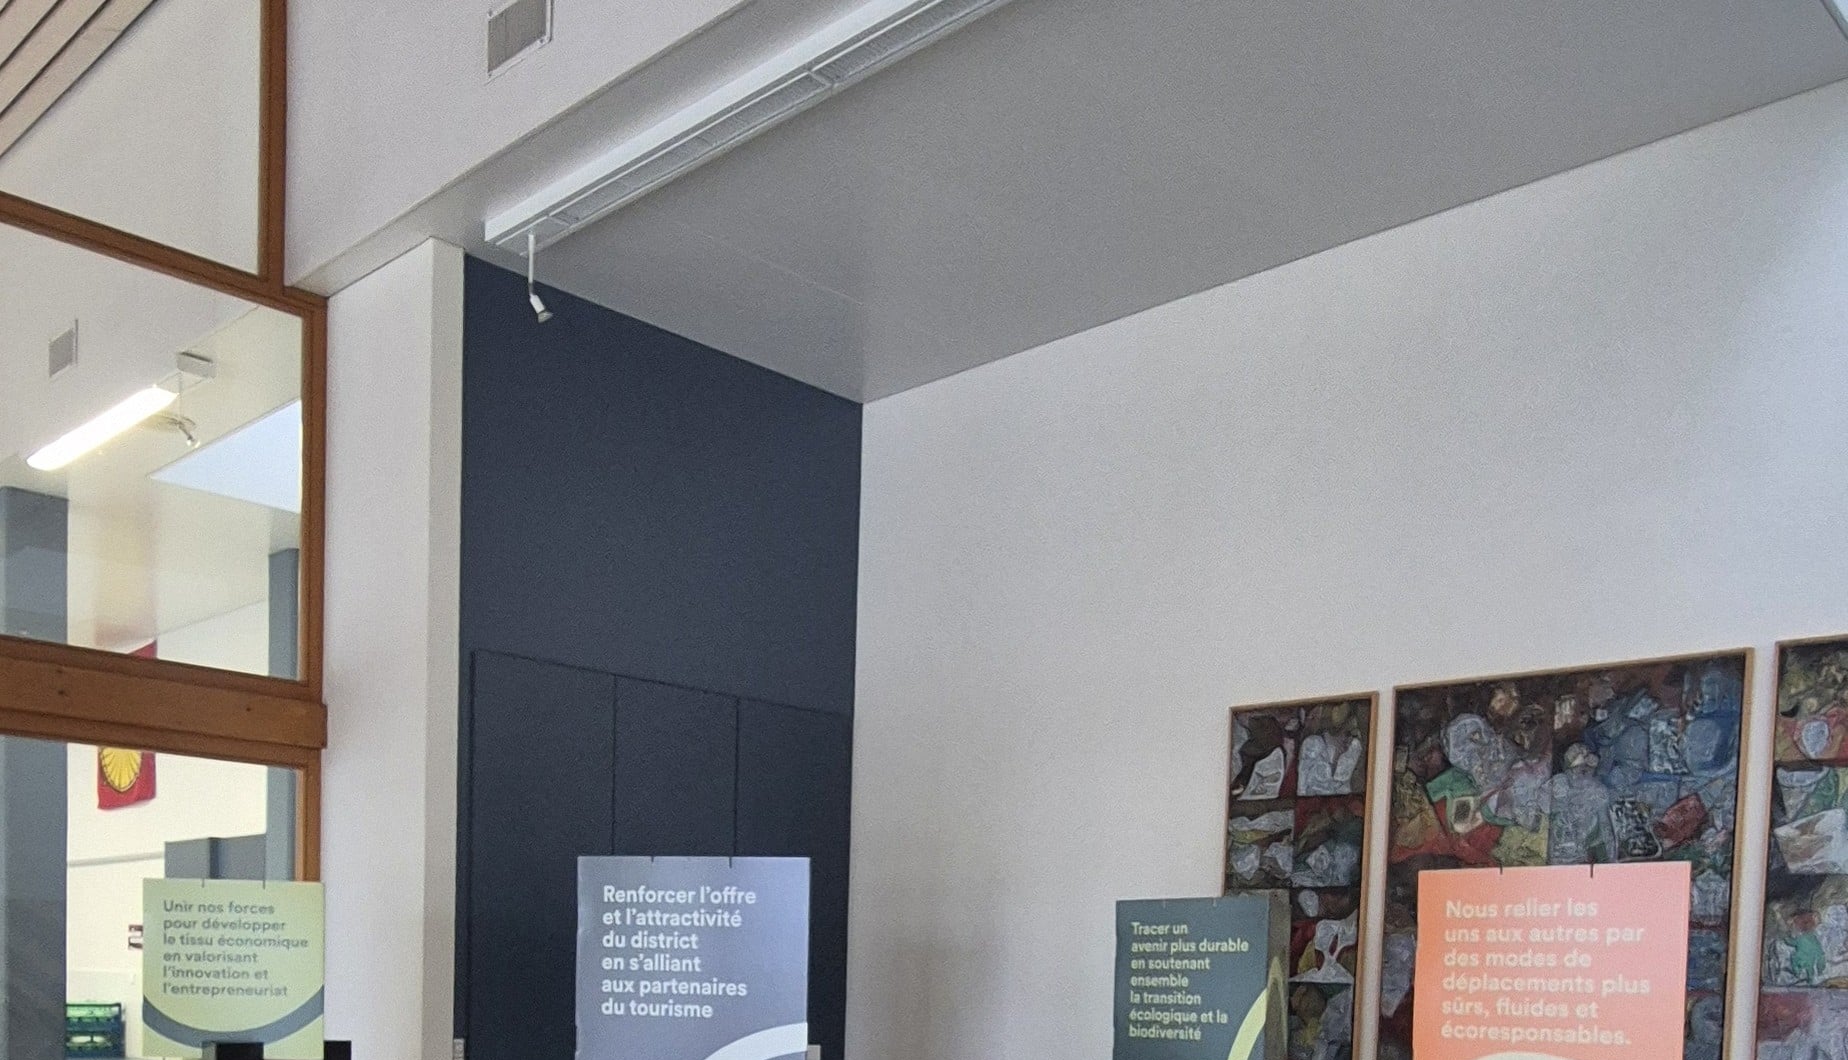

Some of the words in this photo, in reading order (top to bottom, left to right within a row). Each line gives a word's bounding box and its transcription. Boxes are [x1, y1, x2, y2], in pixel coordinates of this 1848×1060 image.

[603, 885, 696, 903] Renforcer
[700, 886, 756, 904] l'offre
[163, 901, 193, 912] Unir
[198, 903, 224, 912] nos
[229, 901, 275, 914] forces
[1446, 901, 1498, 919] Nous
[1504, 899, 1560, 918] relier
[1567, 898, 1597, 916] les
[163, 920, 197, 930] pour
[202, 918, 285, 932] développer
[603, 909, 621, 926] et
[626, 908, 742, 927] l'attractivité
[1131, 922, 1170, 935] Tracer
[1173, 925, 1188, 934] un
[1445, 928, 1480, 943] uns
[1486, 928, 1523, 943] aux
[1529, 927, 1599, 943] autres
[1606, 927, 1645, 945] par
[163, 934, 176, 945] le
[180, 934, 213, 946] tissu
[217, 936, 308, 950] économique
[602, 931, 625, 948] du
[631, 931, 699, 949] district
[1131, 939, 1167, 952] avenir
[1170, 939, 1196, 955] plus
[1199, 938, 1249, 951] durable
[163, 953, 181, 962] en
[186, 951, 258, 963] valorisant
[602, 956, 624, 970] en
[629, 954, 701, 972] s'alliant
[1131, 959, 1145, 969] en
[1148, 957, 1210, 969] soutenant
[1444, 949, 1479, 967] des
[1486, 949, 1557, 967] modes
[1564, 950, 1591, 967] de
[163, 967, 250, 979] l'innovation
[254, 969, 269, 980] et
[1130, 974, 1189, 987] ensemble
[163, 983, 288, 997] l'entrepreneuriat
[601, 980, 635, 992] aux
[639, 978, 748, 997] partenaires
[1443, 973, 1593, 993] déplacements
[1601, 974, 1651, 996] plus
[1130, 990, 1141, 1003] la
[1143, 991, 1201, 1005] transition
[601, 998, 624, 1014] du
[629, 1000, 714, 1018] tourisme
[1129, 1008, 1197, 1023] écologique
[1201, 1011, 1213, 1023] et
[1217, 1010, 1228, 1023] la
[1442, 997, 1489, 1017] sûrs,
[1496, 998, 1568, 1018] fluides
[1575, 1001, 1599, 1018] et
[1129, 1025, 1201, 1040] biodiversité
[1441, 1023, 1632, 1045] écoresponsables.
